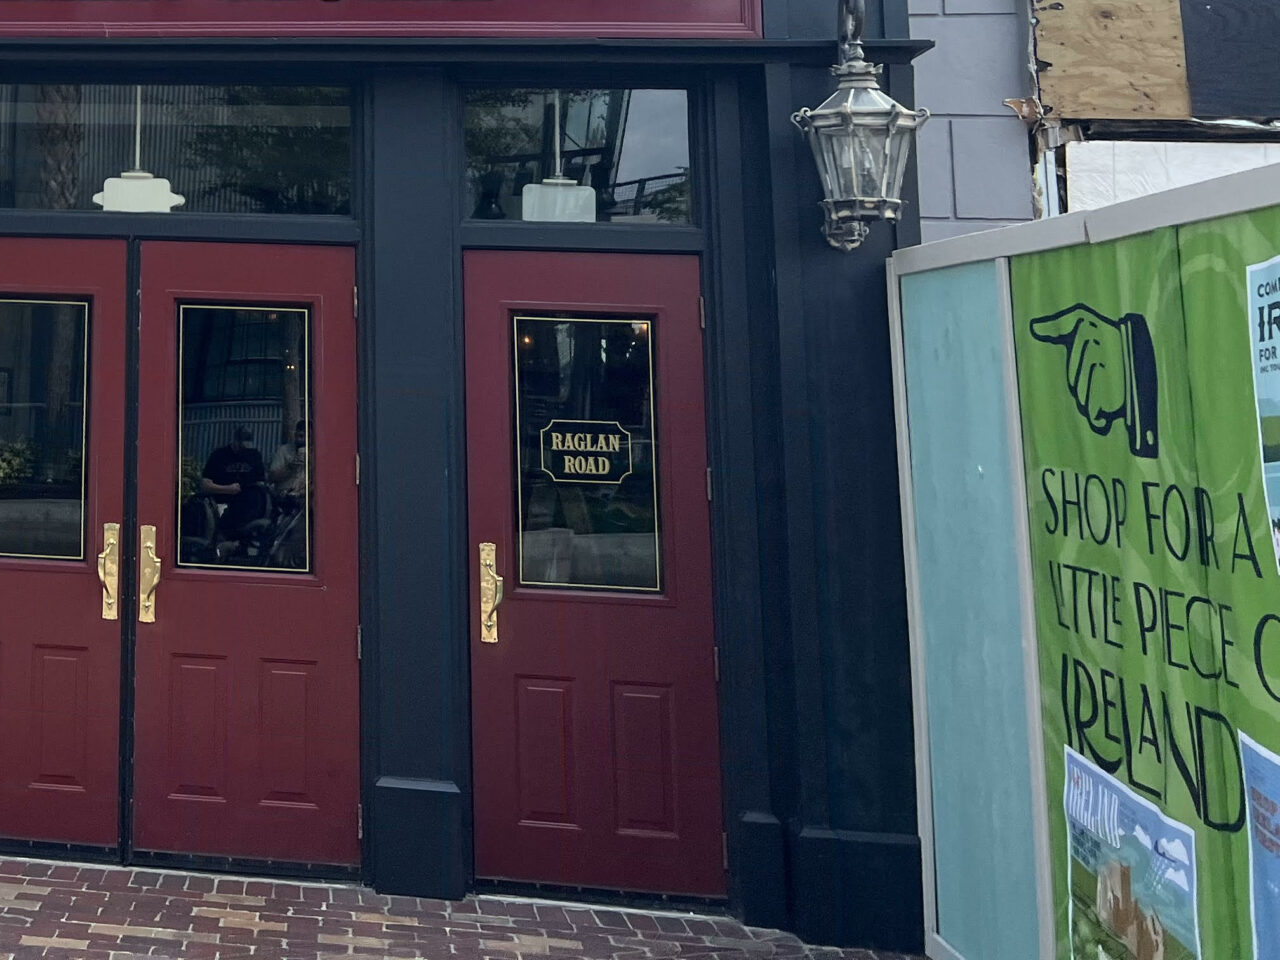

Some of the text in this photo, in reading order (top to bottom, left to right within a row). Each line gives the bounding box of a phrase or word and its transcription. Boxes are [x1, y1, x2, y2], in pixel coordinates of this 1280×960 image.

[1259, 345, 1278, 362] FOR
[551, 432, 621, 452] RAGLAN
[563, 455, 611, 475] ROAD
[1041, 467, 1264, 579] SHOP FOR A
[1048, 559, 1125, 650] LITTLE
[1132, 581, 1241, 690] PIECE
[1060, 652, 1248, 834] IRELAND
